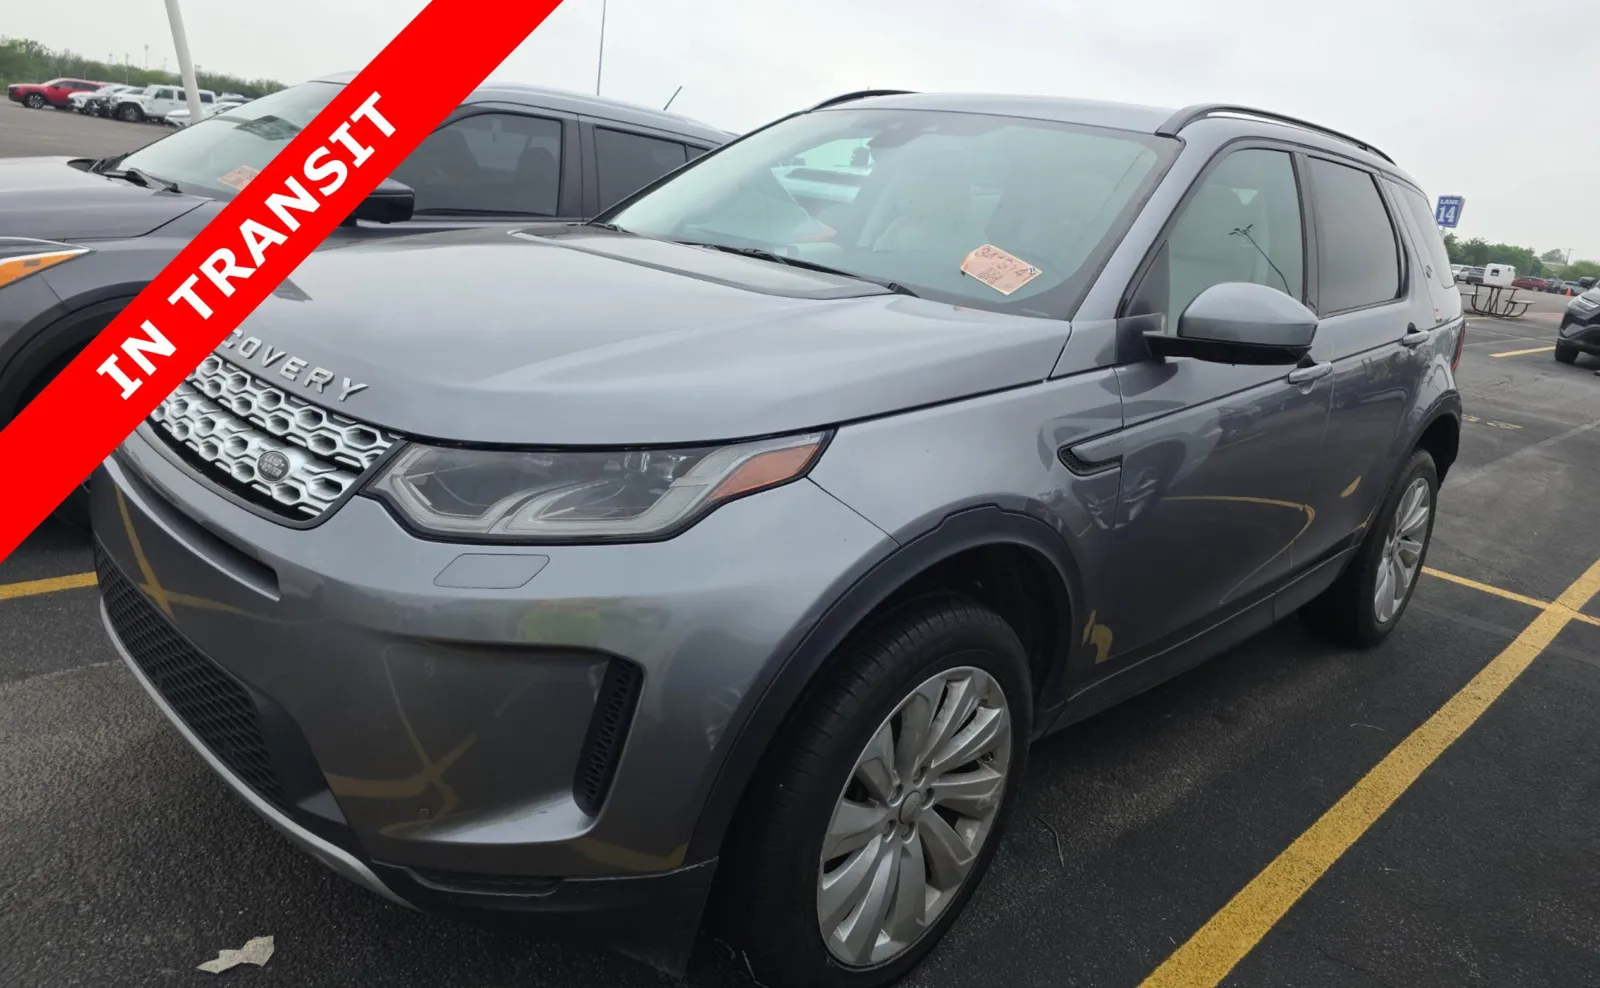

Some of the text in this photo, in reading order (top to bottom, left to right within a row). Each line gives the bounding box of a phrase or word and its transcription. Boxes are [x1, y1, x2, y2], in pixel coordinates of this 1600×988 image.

[1438, 206, 1456, 222] 14
[222, 328, 369, 402] COVERY
[261, 462, 282, 477] ROVER
